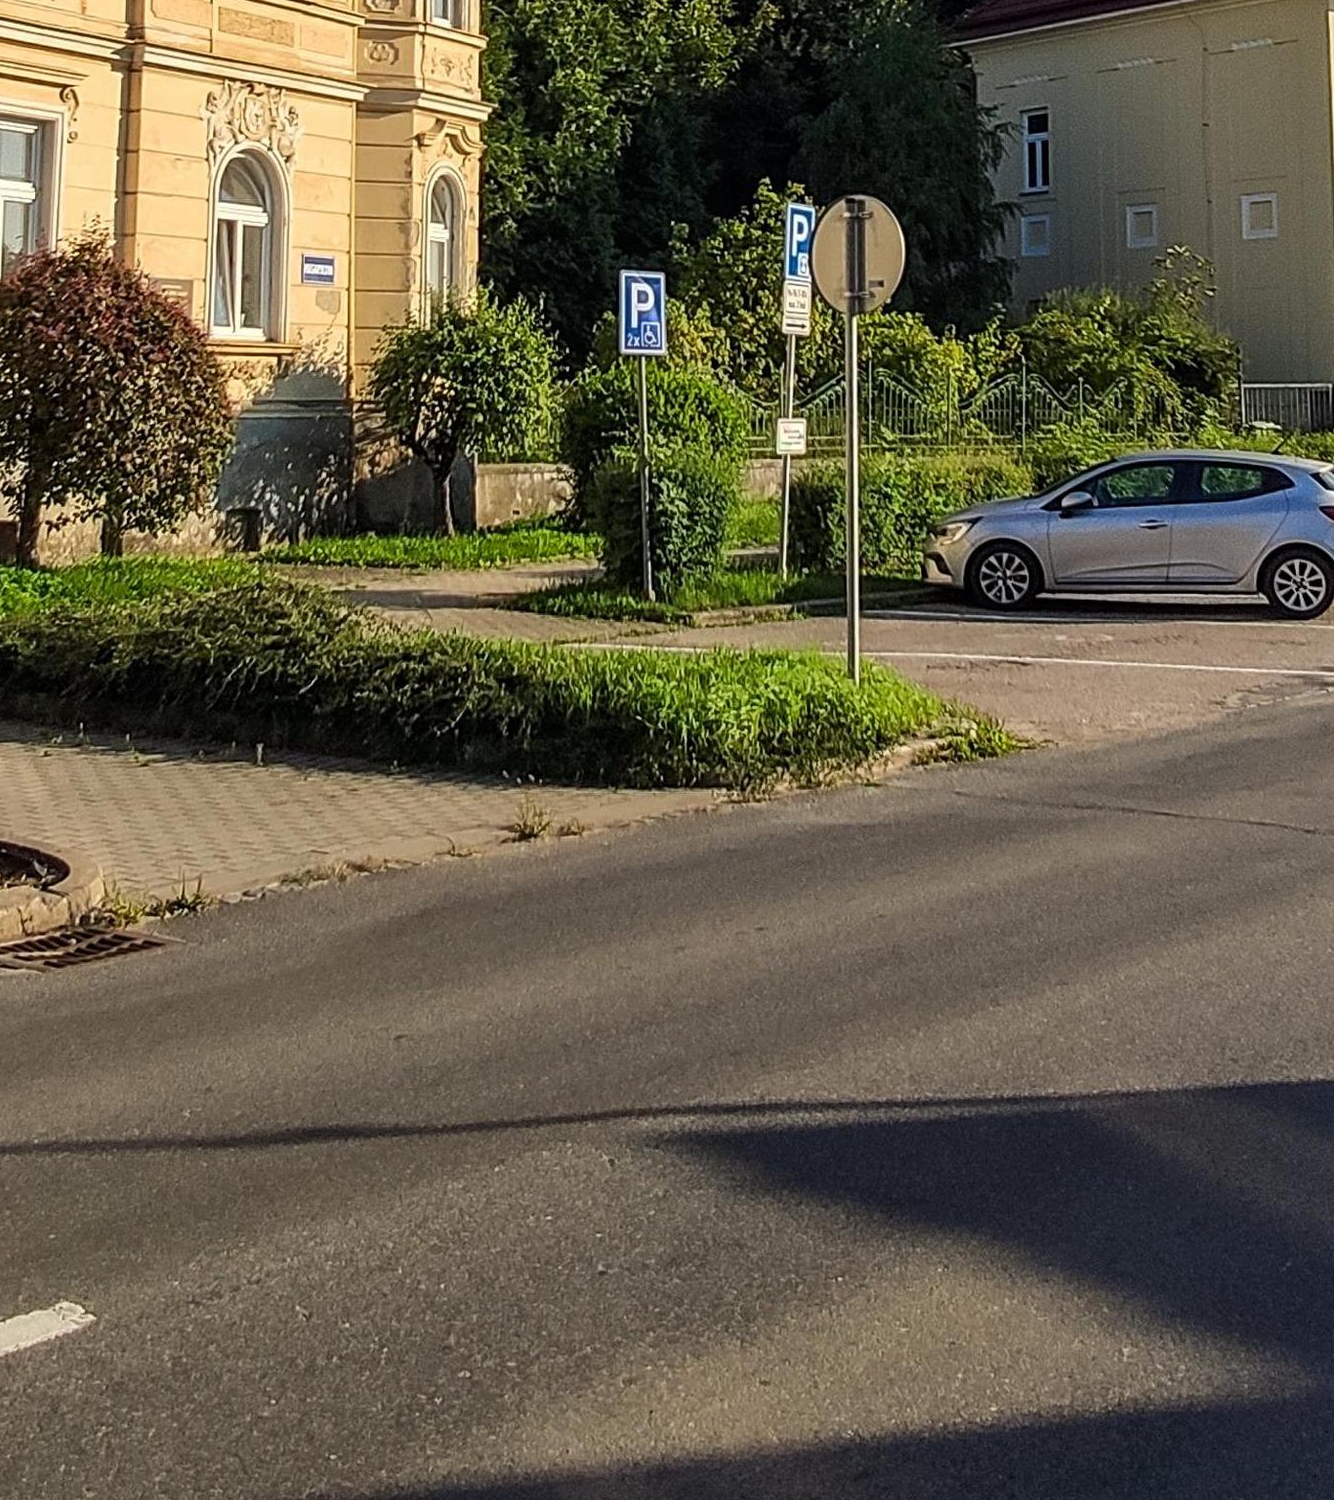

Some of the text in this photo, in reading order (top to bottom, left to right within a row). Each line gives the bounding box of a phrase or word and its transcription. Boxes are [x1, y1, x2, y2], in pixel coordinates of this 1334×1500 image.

[792, 214, 808, 257] P
[631, 282, 655, 328] P
[627, 333, 640, 347] 2x
